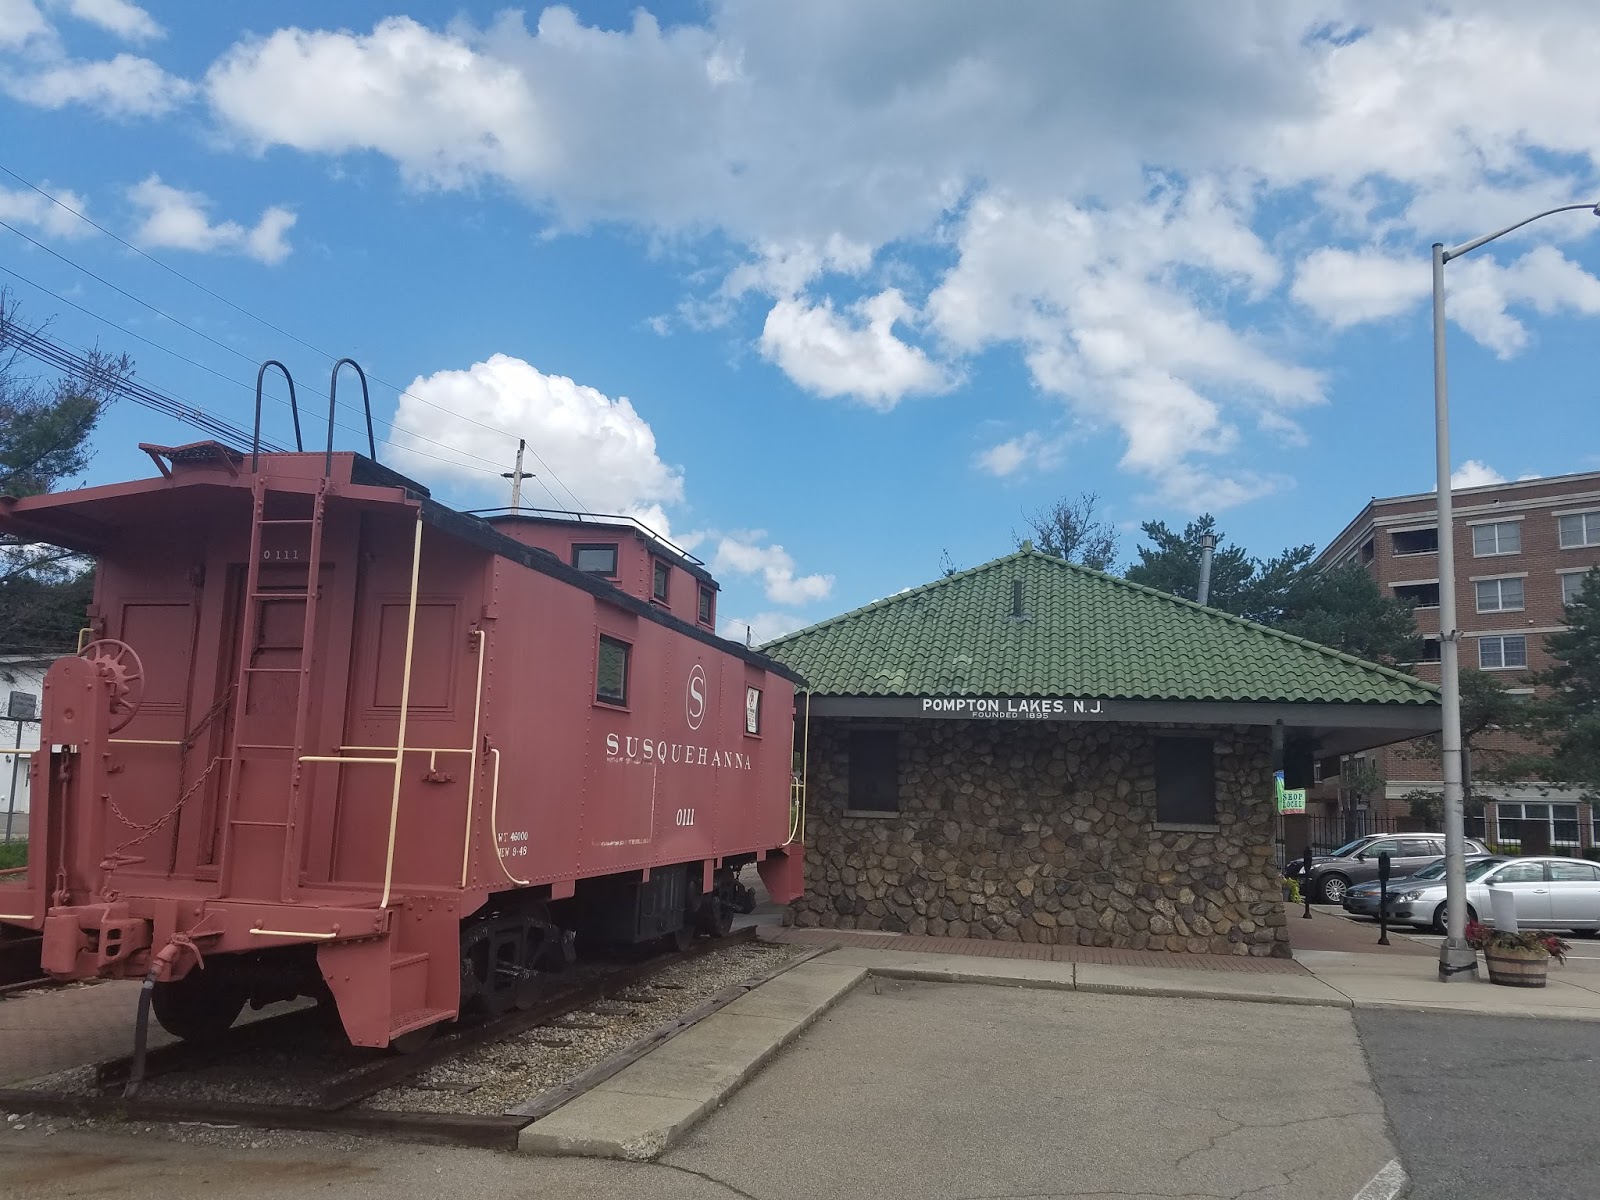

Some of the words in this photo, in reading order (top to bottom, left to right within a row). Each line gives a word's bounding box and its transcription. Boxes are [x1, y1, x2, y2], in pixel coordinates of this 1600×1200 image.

[263, 550, 298, 559] 0111
[922, 699, 999, 712] POMPTON
[972, 711, 1018, 719] FOUNDED
[1025, 711, 1049, 719] 1895
[606, 733, 752, 770] SUSQUEHANNA
[1282, 793, 1303, 801] SHOP
[1282, 800, 1303, 808] LOCAL
[676, 808, 695, 826] 0111
